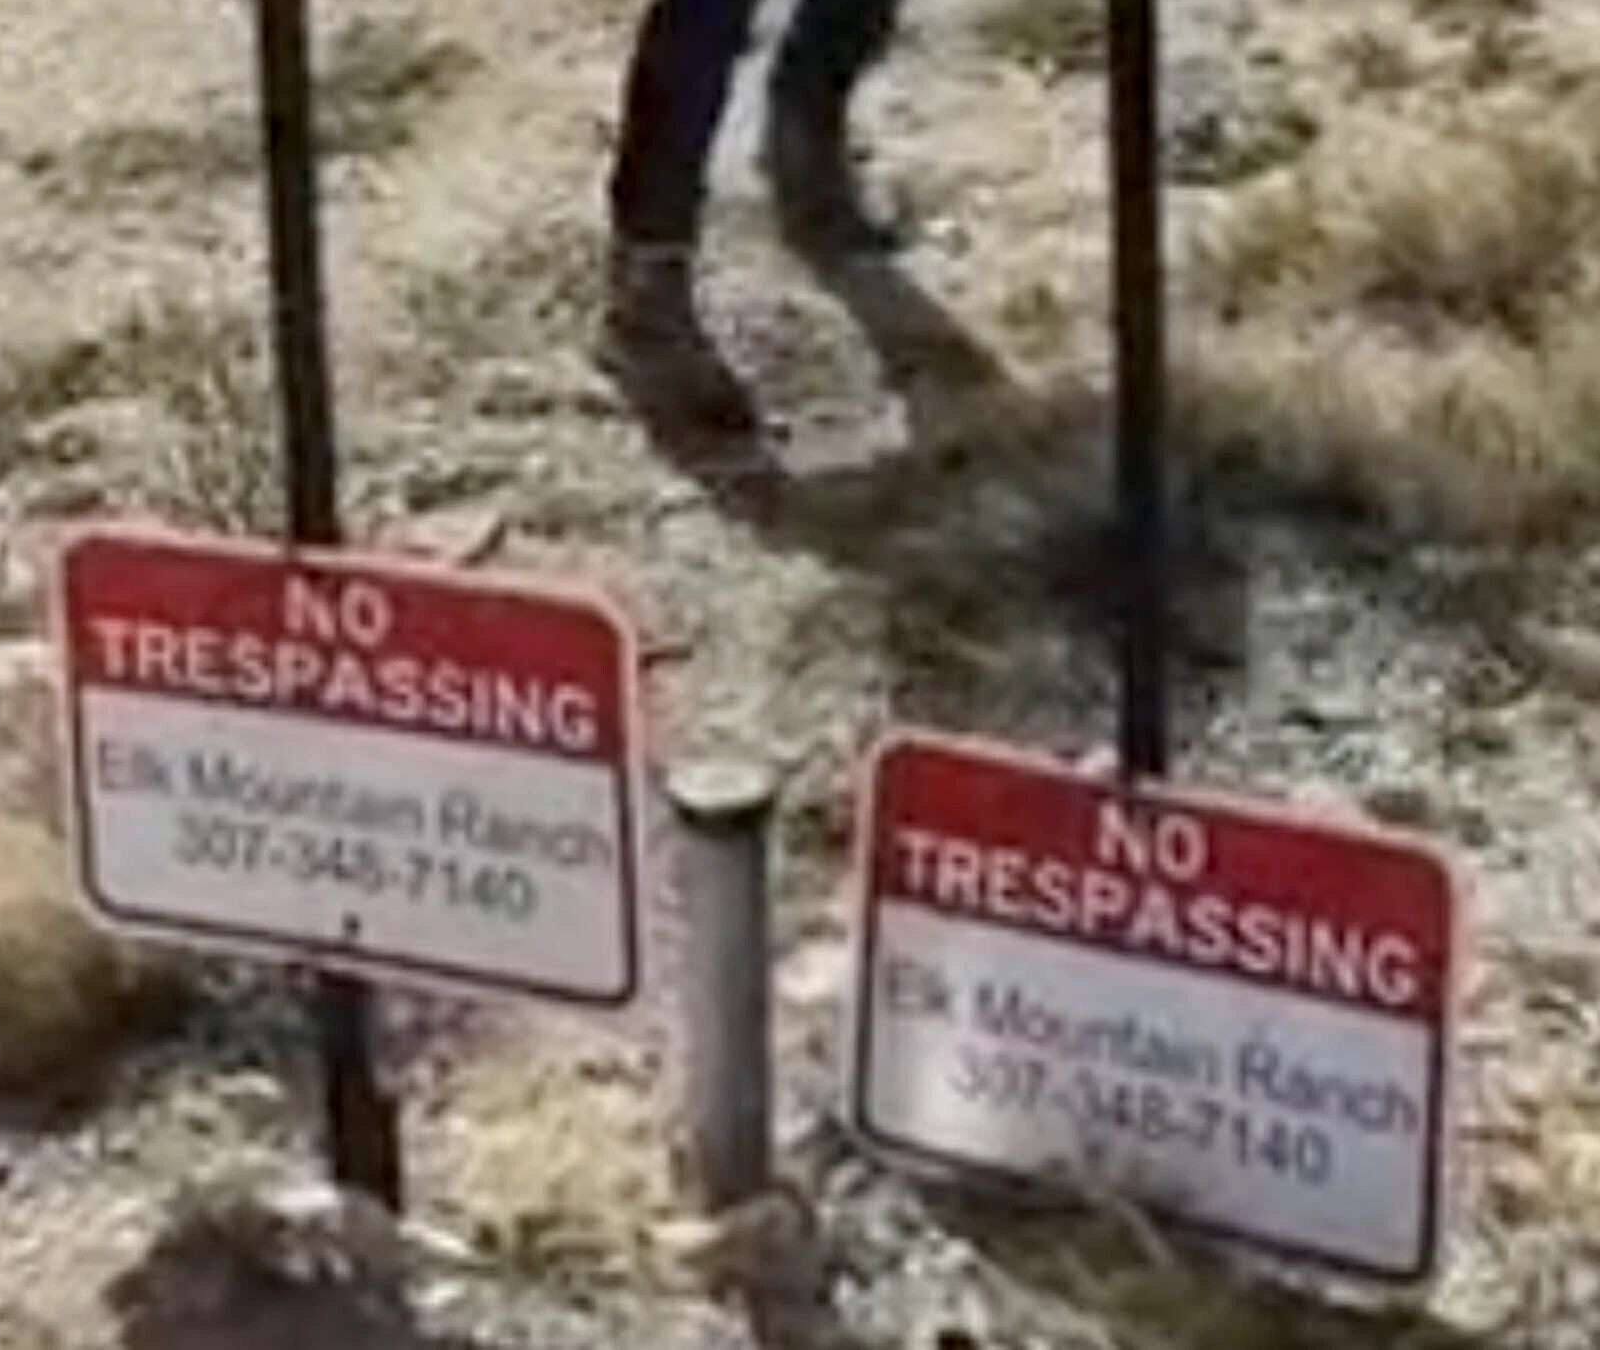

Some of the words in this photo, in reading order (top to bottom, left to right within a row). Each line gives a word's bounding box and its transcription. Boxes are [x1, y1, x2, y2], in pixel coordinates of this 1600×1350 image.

[283, 574, 393, 647] NO
[89, 616, 596, 749] TRESPASSING
[186, 746, 424, 838] Mountain
[438, 790, 611, 867] Ranch
[1099, 804, 1208, 881] NO
[898, 829, 1419, 1004] TRESPASSING
[975, 979, 1222, 1086] Mountain
[1236, 1041, 1418, 1133] Ranch
